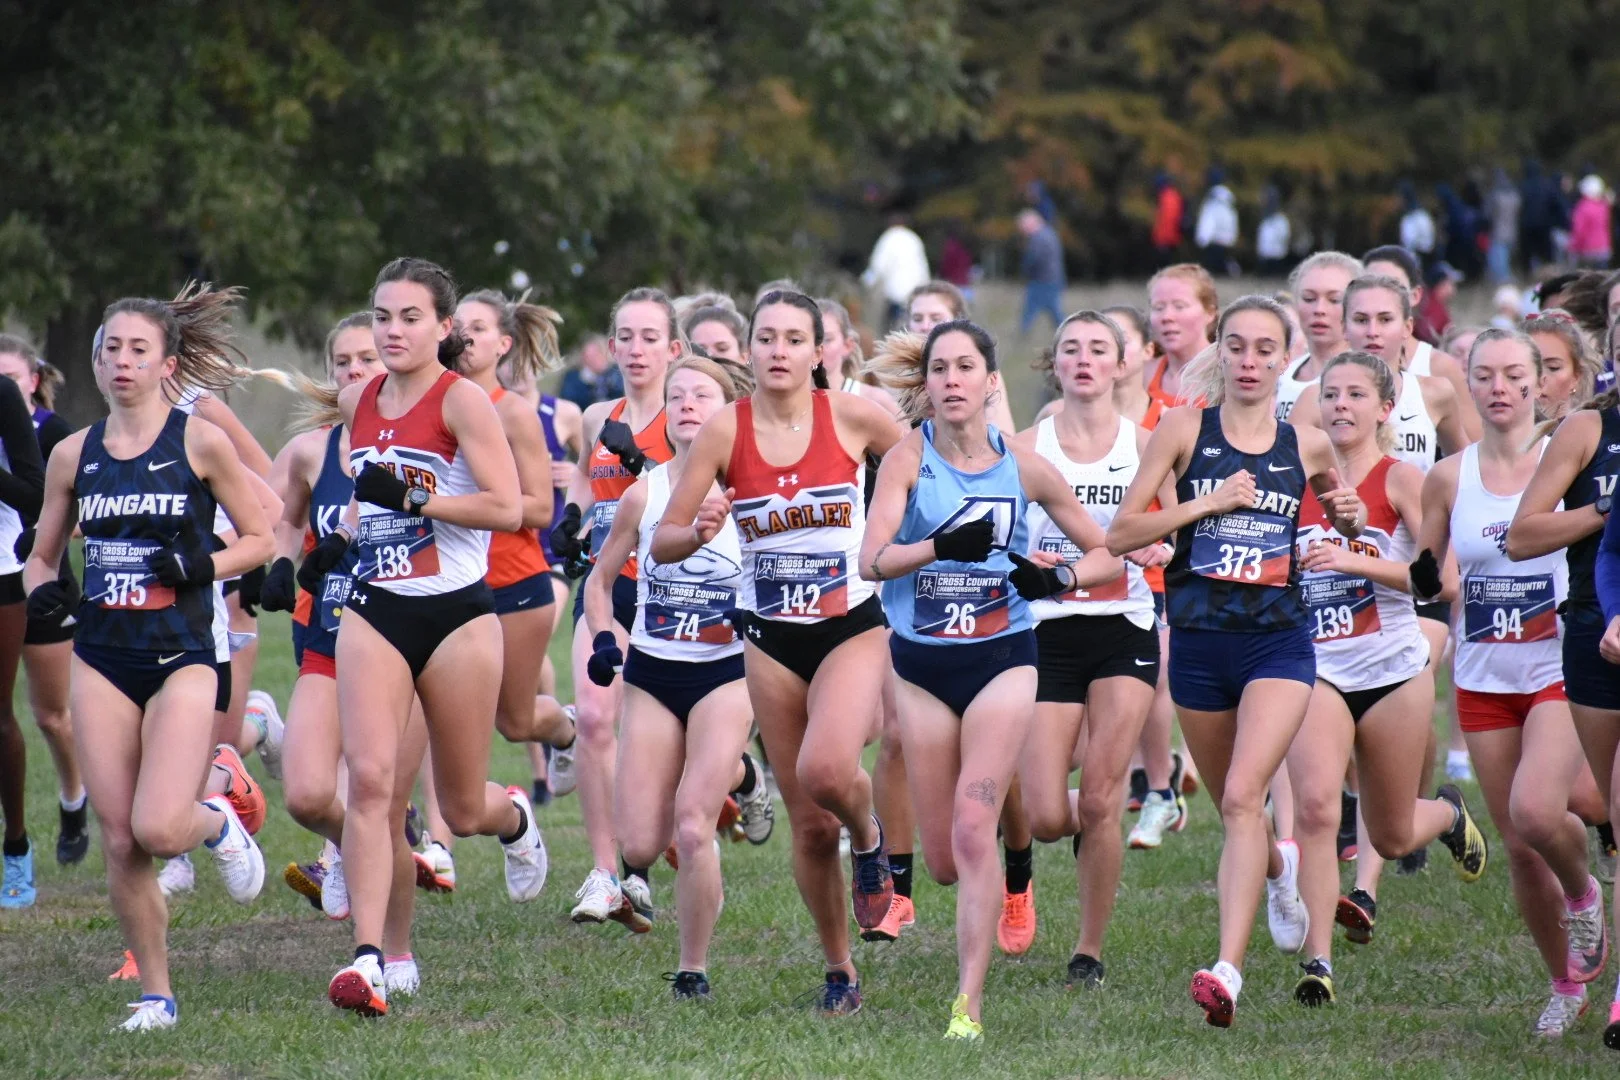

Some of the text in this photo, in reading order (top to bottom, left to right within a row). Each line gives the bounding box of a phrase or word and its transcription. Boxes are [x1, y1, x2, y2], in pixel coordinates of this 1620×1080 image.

[1070, 485, 1128, 504] ERSO
[1190, 479, 1300, 518] WGATE
[78, 494, 188, 522] WINGATE
[372, 520, 390, 530] CROSS
[392, 516, 424, 528] COUNTRY
[738, 502, 852, 543] FLAGLER
[1219, 527, 1264, 538] CHAMPIONSHIPS
[1220, 518, 1286, 534] CROSS COUNTRY
[1482, 525, 1508, 538] COUG
[102, 546, 163, 556] CROSS COUNT
[375, 544, 412, 578] 138
[1216, 544, 1262, 580] 373
[777, 558, 840, 568] CROSS COUNTRY
[104, 572, 146, 606] 375
[670, 587, 730, 600] CROSS COUNTRY
[938, 578, 1002, 586] CROSS COUNTRY
[1311, 582, 1332, 592] CROSS
[1333, 579, 1366, 590] COUNTRY
[1486, 581, 1547, 592] CROSS COUNTRY
[780, 584, 820, 614] 142
[674, 612, 700, 641] 74
[944, 602, 976, 634] 26
[1314, 605, 1354, 639] 139
[1493, 608, 1524, 640] 94
